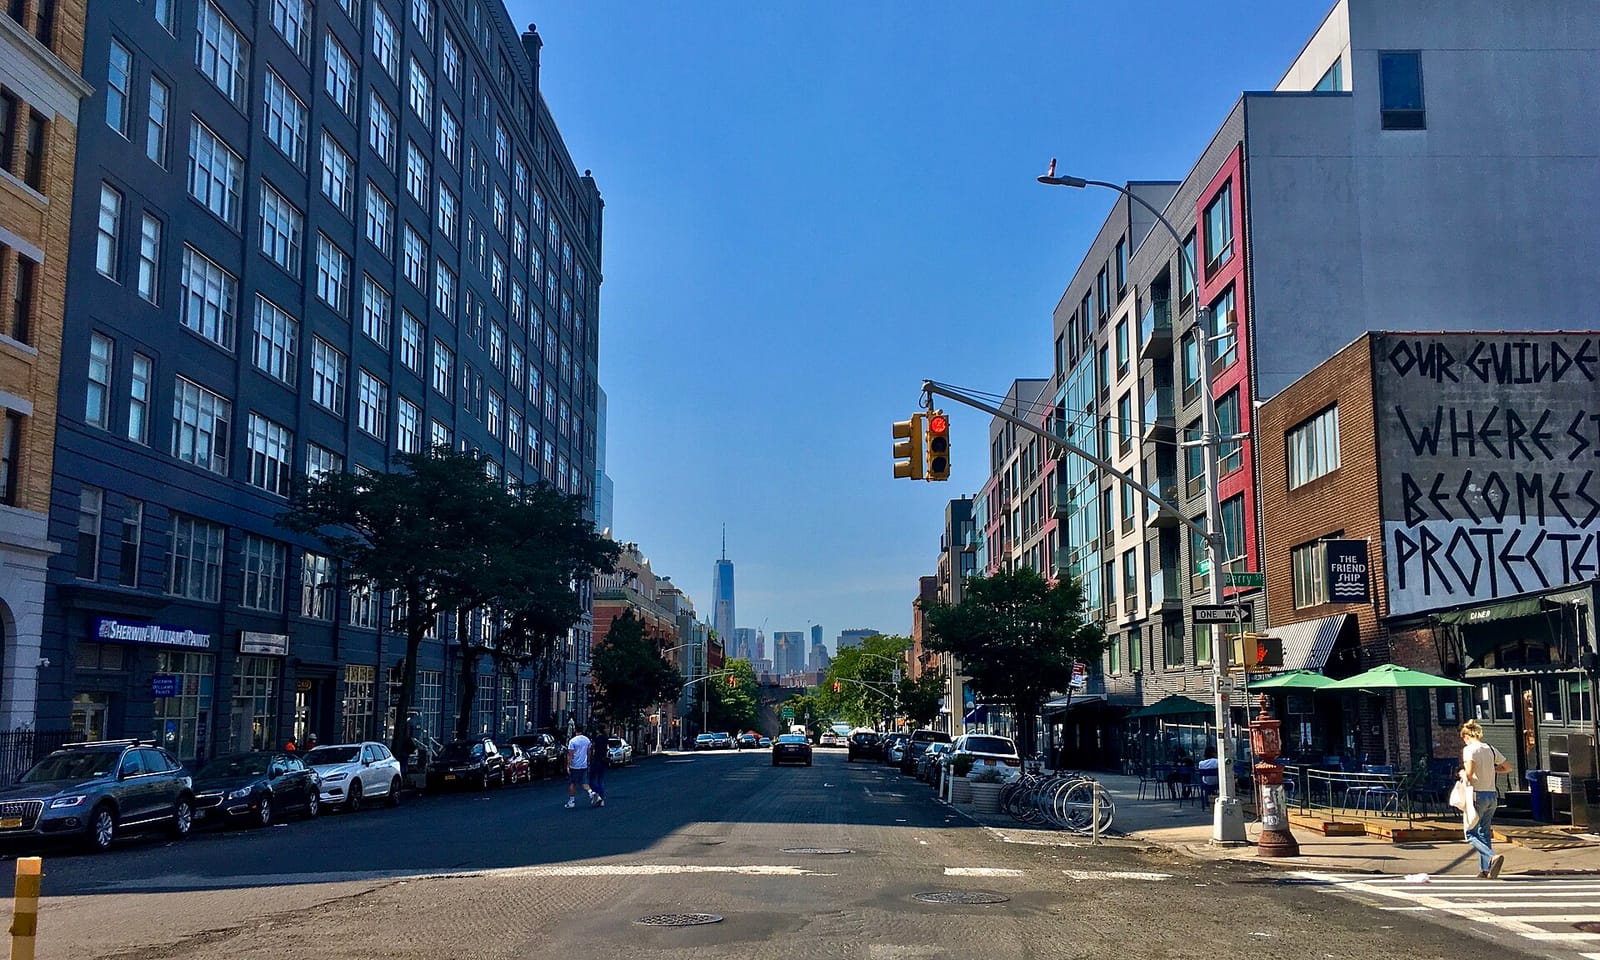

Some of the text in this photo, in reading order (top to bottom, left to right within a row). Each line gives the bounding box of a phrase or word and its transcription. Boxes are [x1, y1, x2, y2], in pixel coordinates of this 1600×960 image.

[1388, 339, 1600, 384] OUR GUILDE
[1395, 405, 1554, 461] WHERE
[1401, 470, 1600, 529] BECOMES
[1339, 555, 1357, 563] THE
[1394, 525, 1600, 597] PROTECTE
[1331, 563, 1366, 573] FRIEND
[1225, 574, 1251, 585] Berry
[1337, 573, 1361, 582] SHIP
[1200, 610, 1218, 618] ONE
